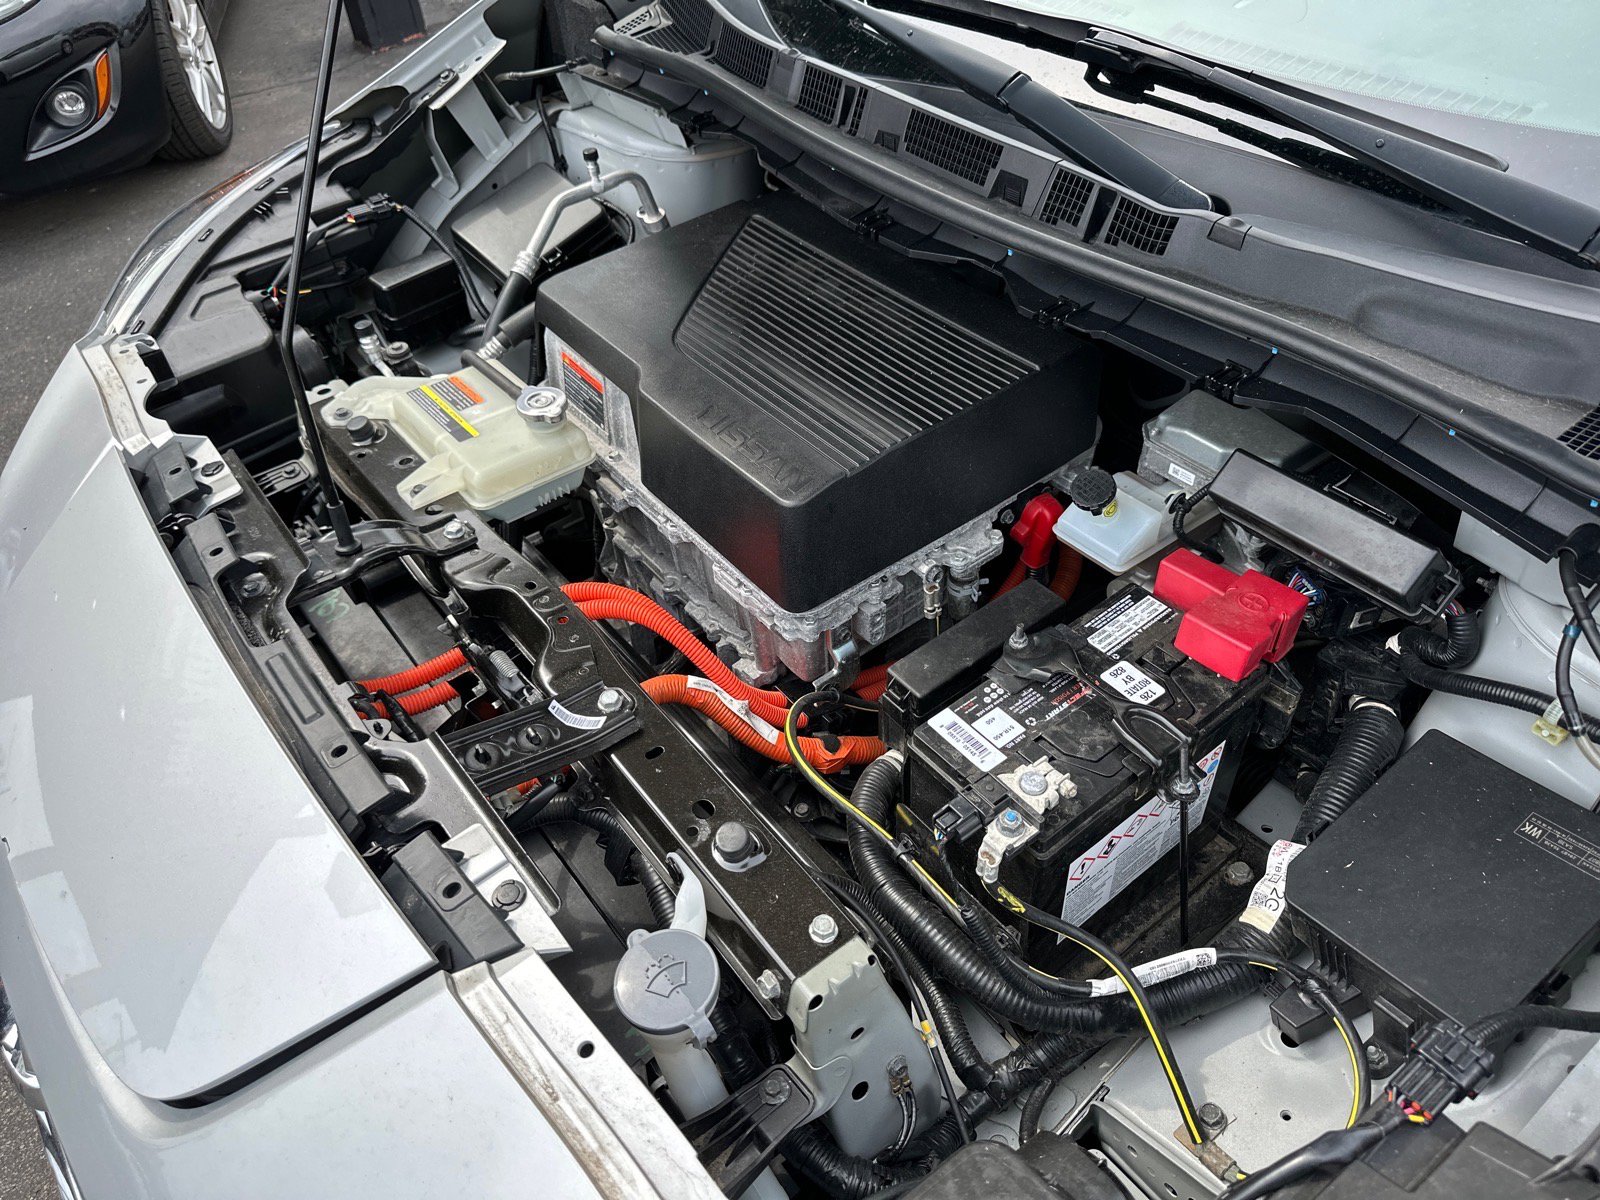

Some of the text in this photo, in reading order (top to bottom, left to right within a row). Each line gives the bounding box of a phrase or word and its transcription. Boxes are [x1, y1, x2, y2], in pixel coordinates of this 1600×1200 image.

[693, 404, 814, 494] NISSAN
[1109, 666, 1127, 679] 826
[1121, 674, 1136, 686] BY
[1124, 678, 1152, 697] ROTATE
[1140, 689, 1157, 701] 126
[992, 724, 1015, 741] 51R-450
[1520, 821, 1543, 840] WK
